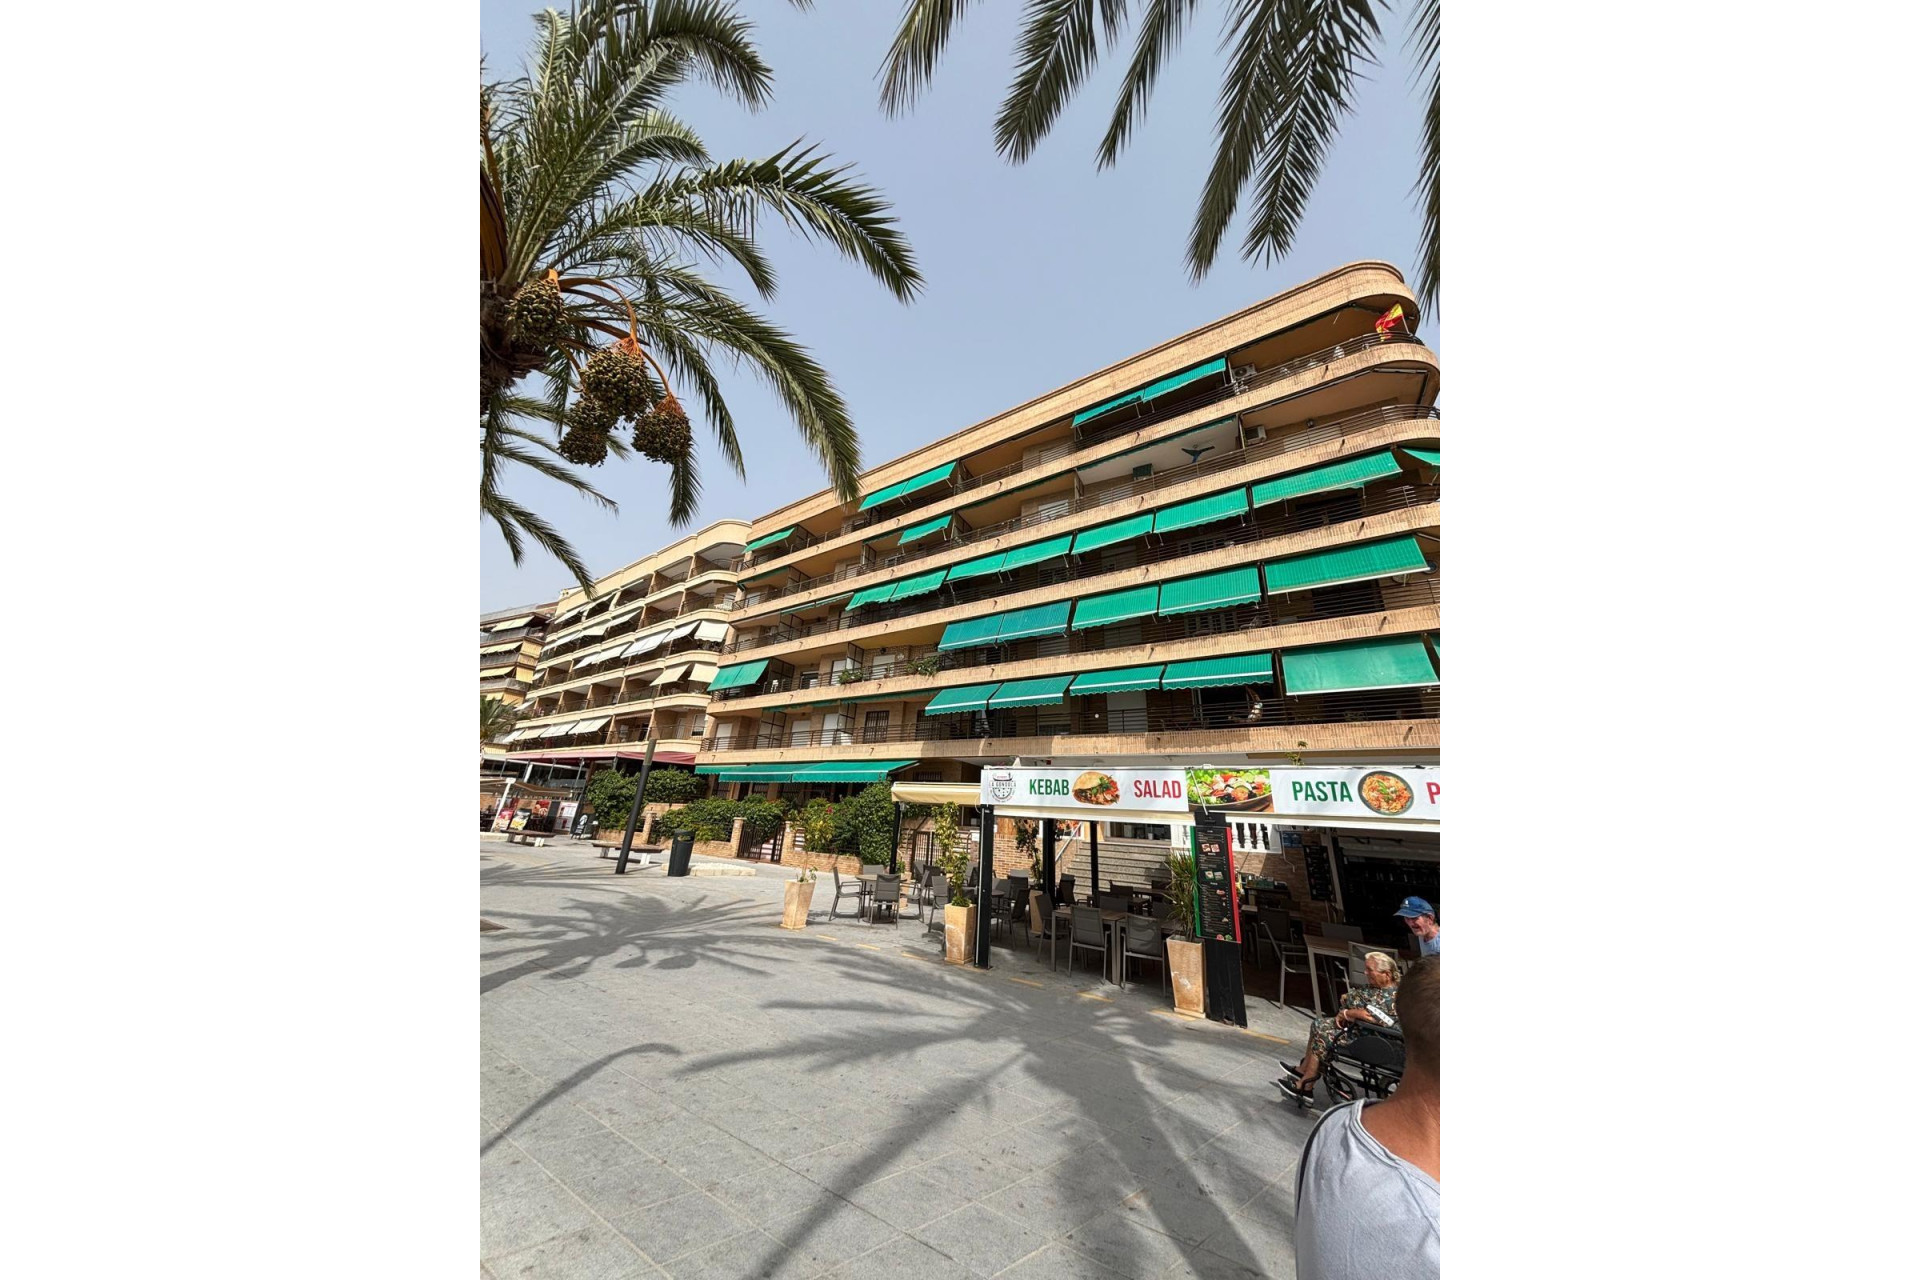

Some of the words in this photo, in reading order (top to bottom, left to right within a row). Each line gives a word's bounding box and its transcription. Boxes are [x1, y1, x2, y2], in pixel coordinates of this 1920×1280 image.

[1029, 779, 1069, 796] KEBAB
[1134, 780, 1182, 798] SALAD
[1292, 781, 1353, 802] PASTA
